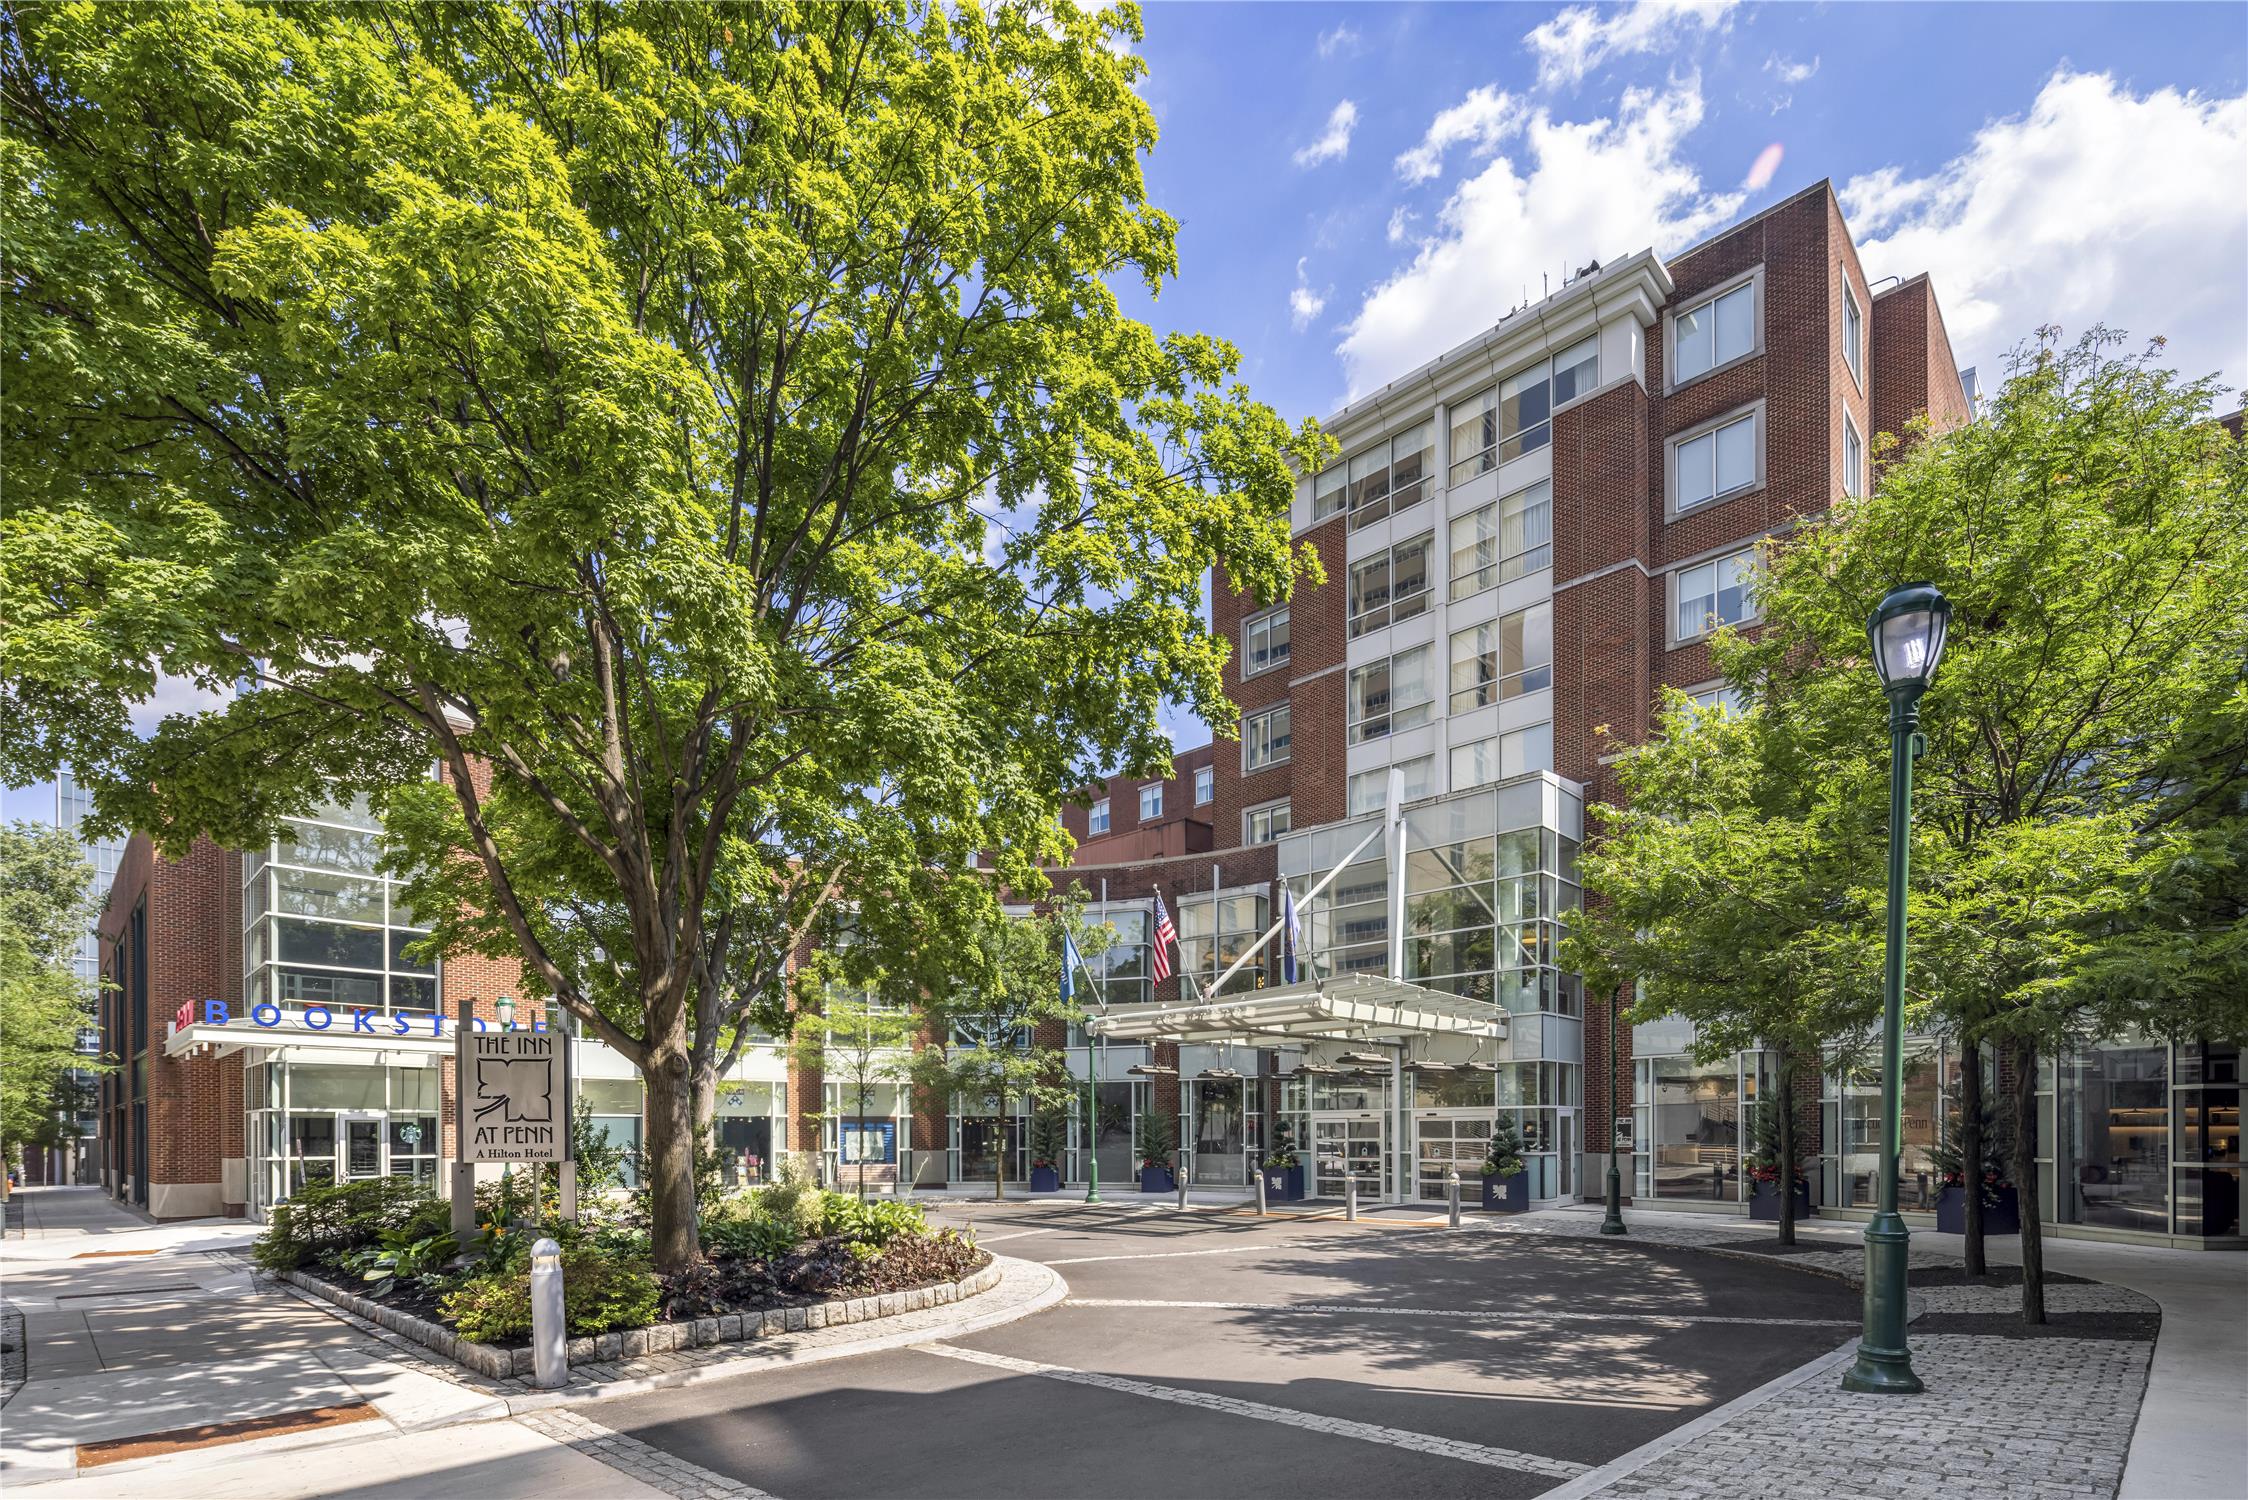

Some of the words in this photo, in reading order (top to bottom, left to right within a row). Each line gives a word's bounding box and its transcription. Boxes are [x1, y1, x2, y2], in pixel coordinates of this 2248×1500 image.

[474, 1036, 510, 1054] THE
[518, 1037, 552, 1054] INN
[474, 1126, 498, 1144] AT
[503, 1126, 553, 1144] PENN
[476, 1149, 485, 1159] A
[488, 1148, 521, 1158] Hilton
[525, 1148, 553, 1158] Hotel
